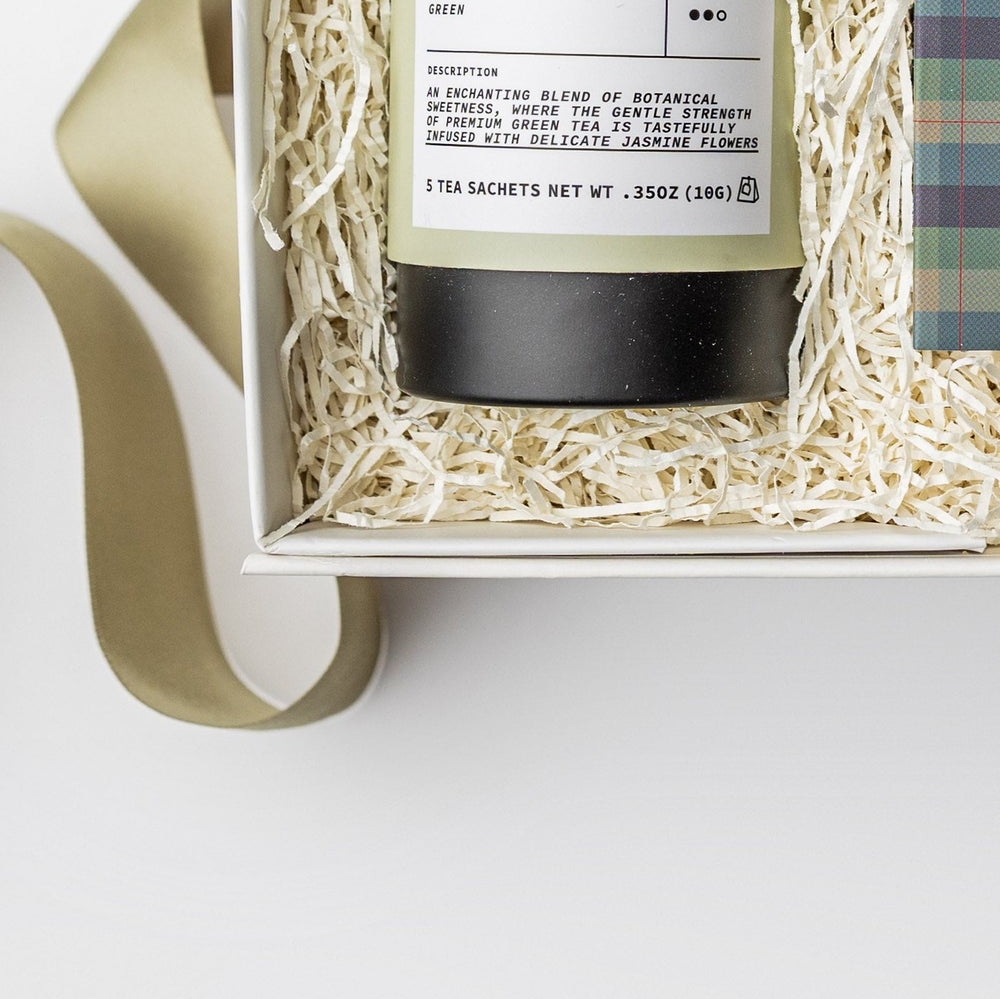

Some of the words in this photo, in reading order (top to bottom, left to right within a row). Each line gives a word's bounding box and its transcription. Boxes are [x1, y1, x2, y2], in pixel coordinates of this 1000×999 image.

[428, 4, 465, 16] GREEN
[428, 66, 498, 77] DESCRIPTION
[427, 87, 440, 98] AN
[446, 88, 531, 101] ENCHANTING
[541, 90, 591, 102] BLEND
[602, 92, 622, 103] OF
[633, 92, 718, 105] BOTANICAL
[426, 101, 501, 117] SWEETNESS,
[512, 104, 560, 116] WHERE
[572, 106, 601, 117] THE
[612, 107, 672, 119] GENTLE
[682, 108, 752, 120] STRENGTH
[427, 116, 440, 127] OF
[446, 117, 502, 129] PREMIUM
[511, 119, 560, 131] GREEN
[571, 120, 601, 132] TEA
[612, 121, 632, 133] IS
[643, 122, 737, 134] TASTEFULLY
[426, 130, 476, 143] INFUSED
[484, 133, 521, 145] WITH
[530, 134, 611, 147] DELICATE
[622, 136, 691, 148] JASMINE
[701, 137, 759, 149] FLOWERS
[426, 179, 433, 192] 5
[437, 180, 462, 194] TEA
[468, 181, 541, 197] SACHETS
[548, 184, 583, 198] NET
[590, 185, 614, 199] WT
[684, 184, 732, 202] (10G)
